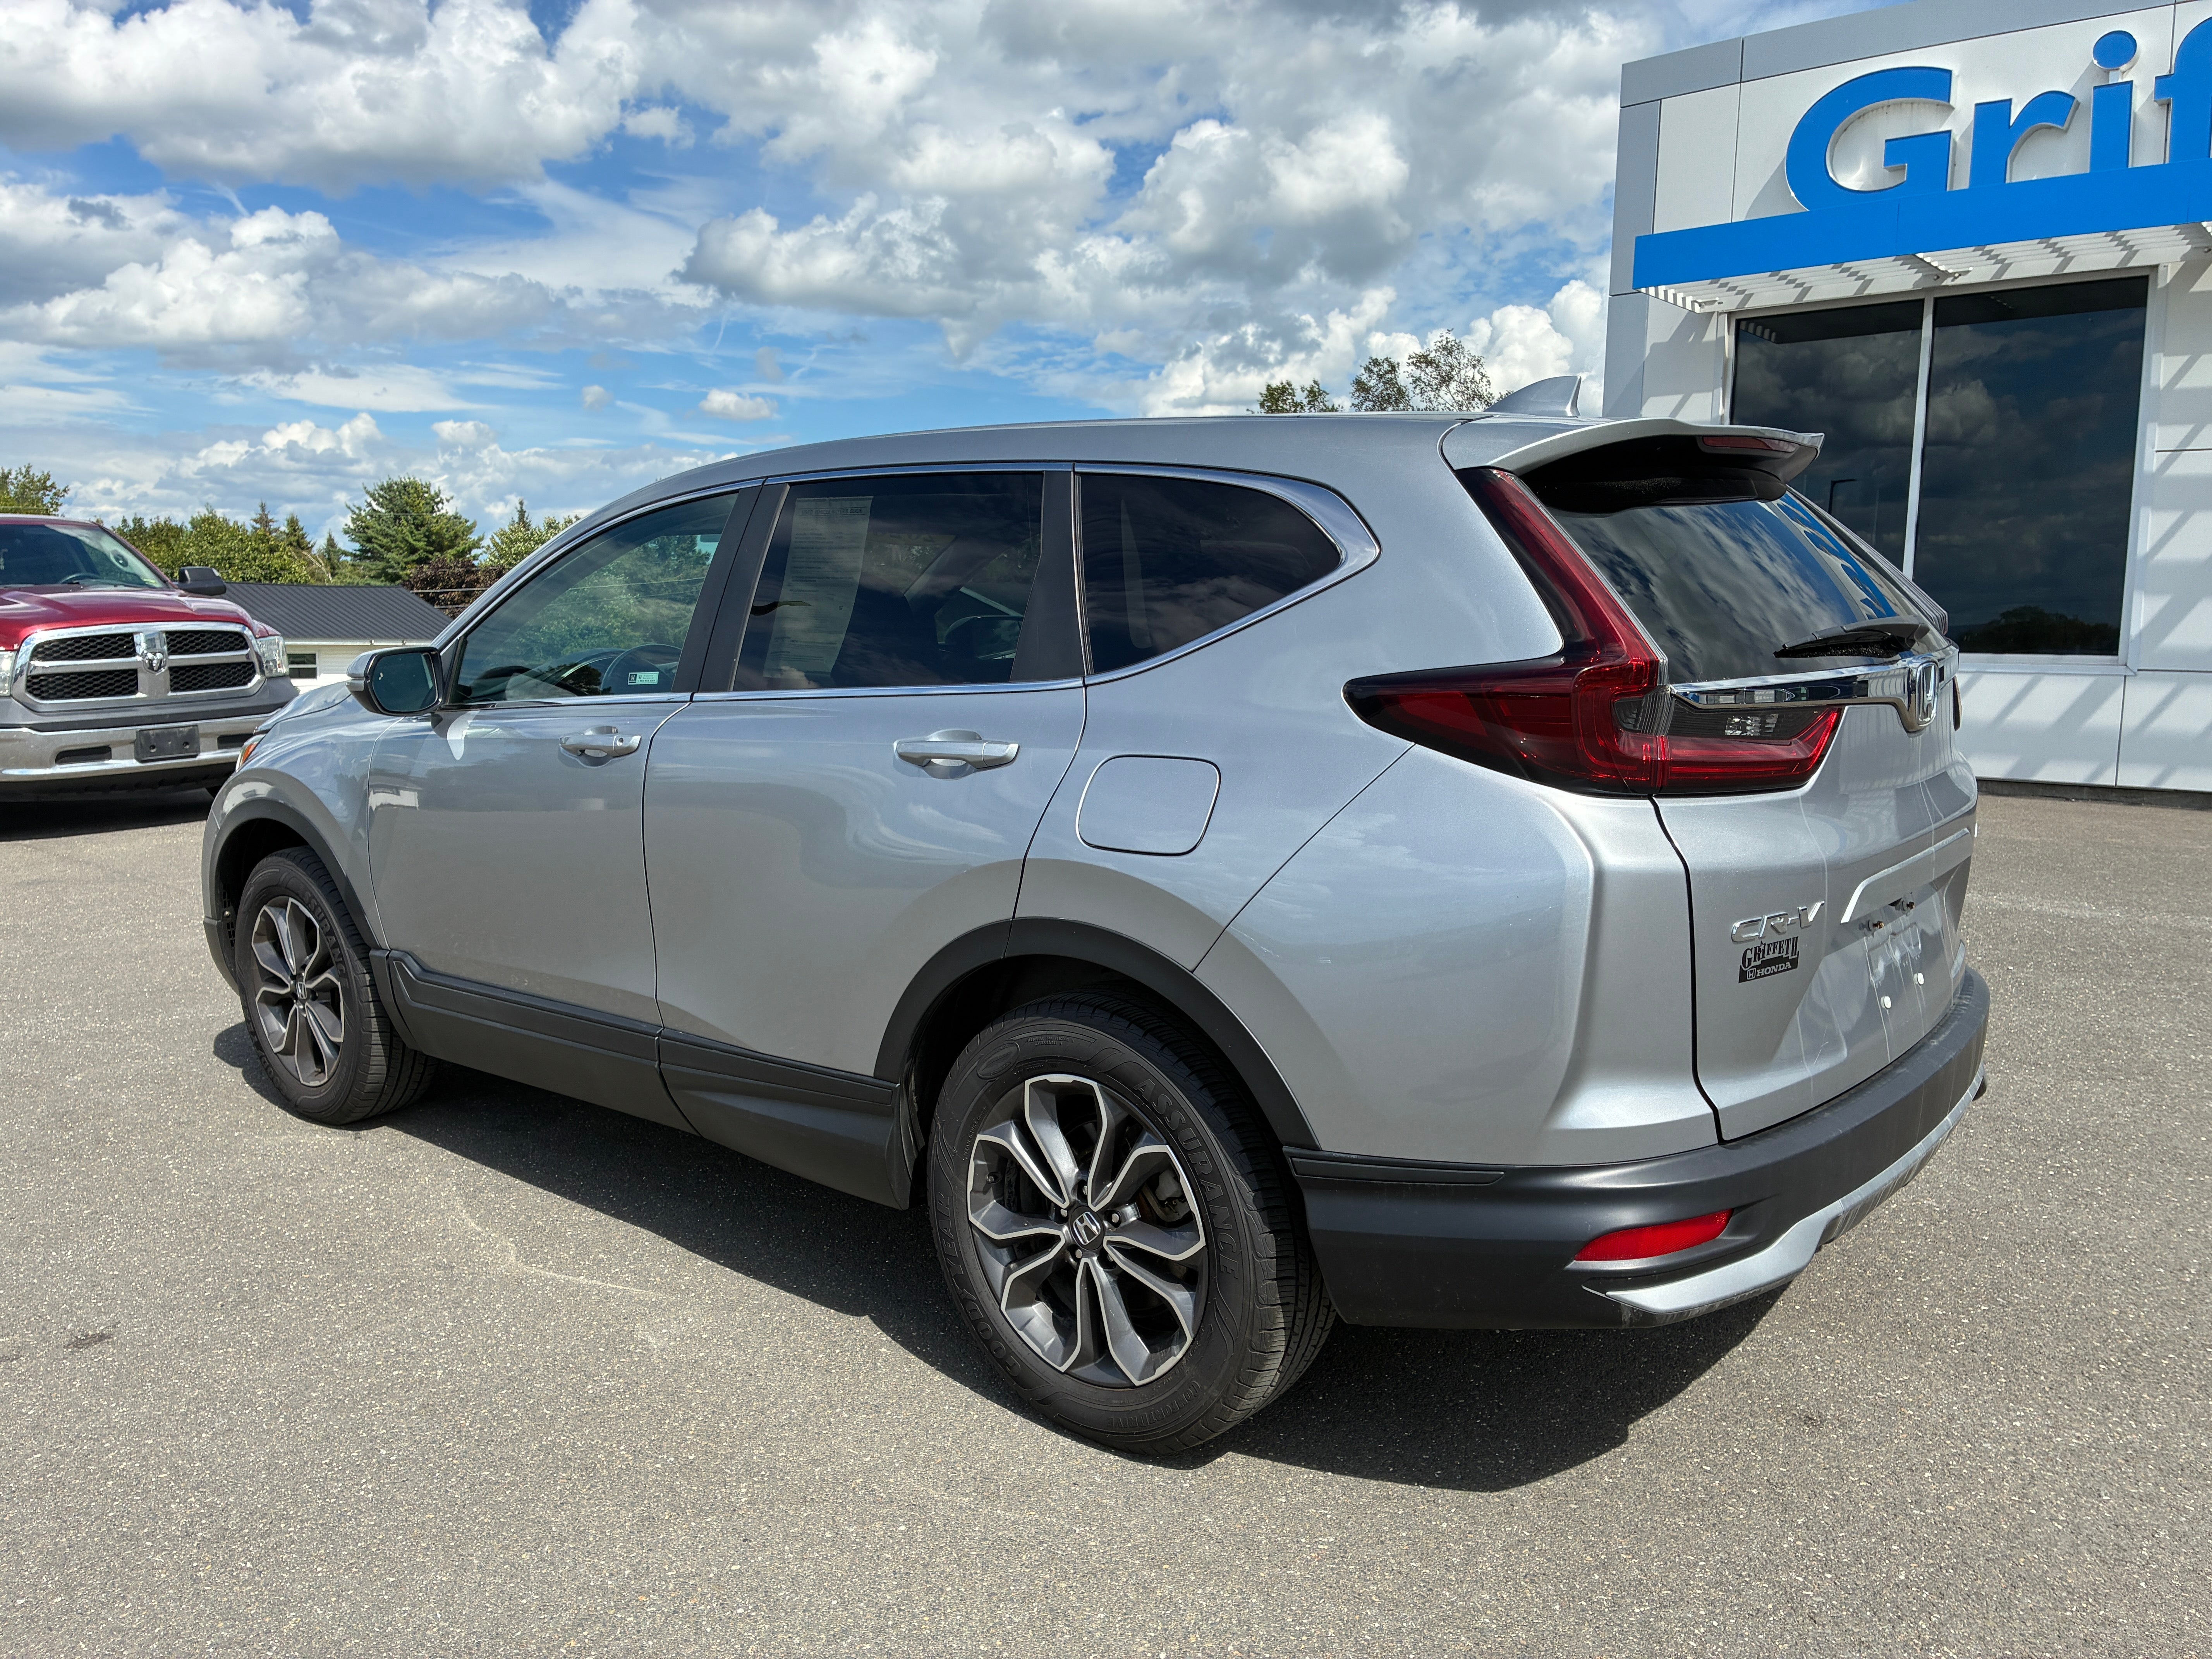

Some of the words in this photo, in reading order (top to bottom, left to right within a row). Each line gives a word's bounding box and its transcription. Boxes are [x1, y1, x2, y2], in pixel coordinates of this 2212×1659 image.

[1731, 901, 1825, 943] CR-V
[1742, 936, 1799, 969] GRIFFETH
[1756, 962, 1792, 977] HONDA
[1133, 1079, 1238, 1278] ASSURANCE
